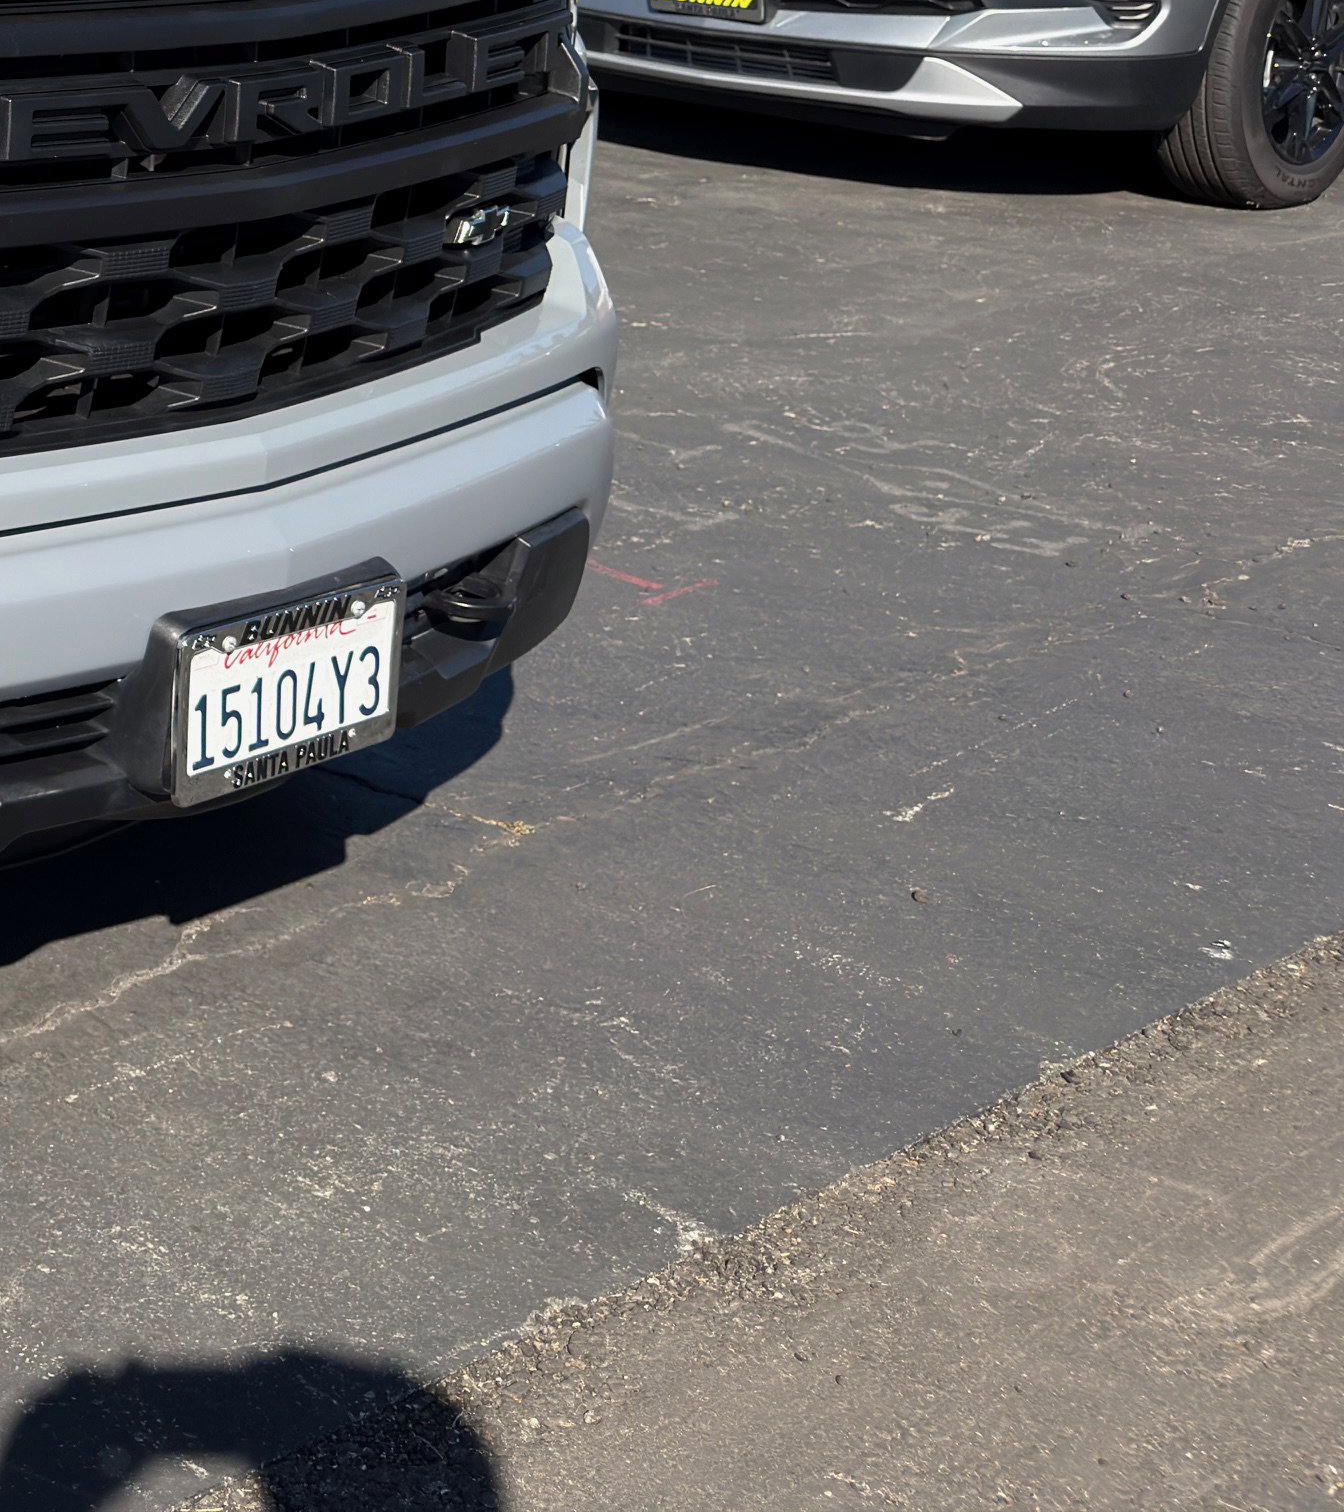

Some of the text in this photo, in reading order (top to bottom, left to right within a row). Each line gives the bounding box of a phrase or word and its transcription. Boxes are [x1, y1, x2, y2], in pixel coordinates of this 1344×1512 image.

[240, 594, 352, 647] BUNNIN
[193, 646, 380, 771] 15104Y3
[232, 730, 351, 789] SANTA PAULA
